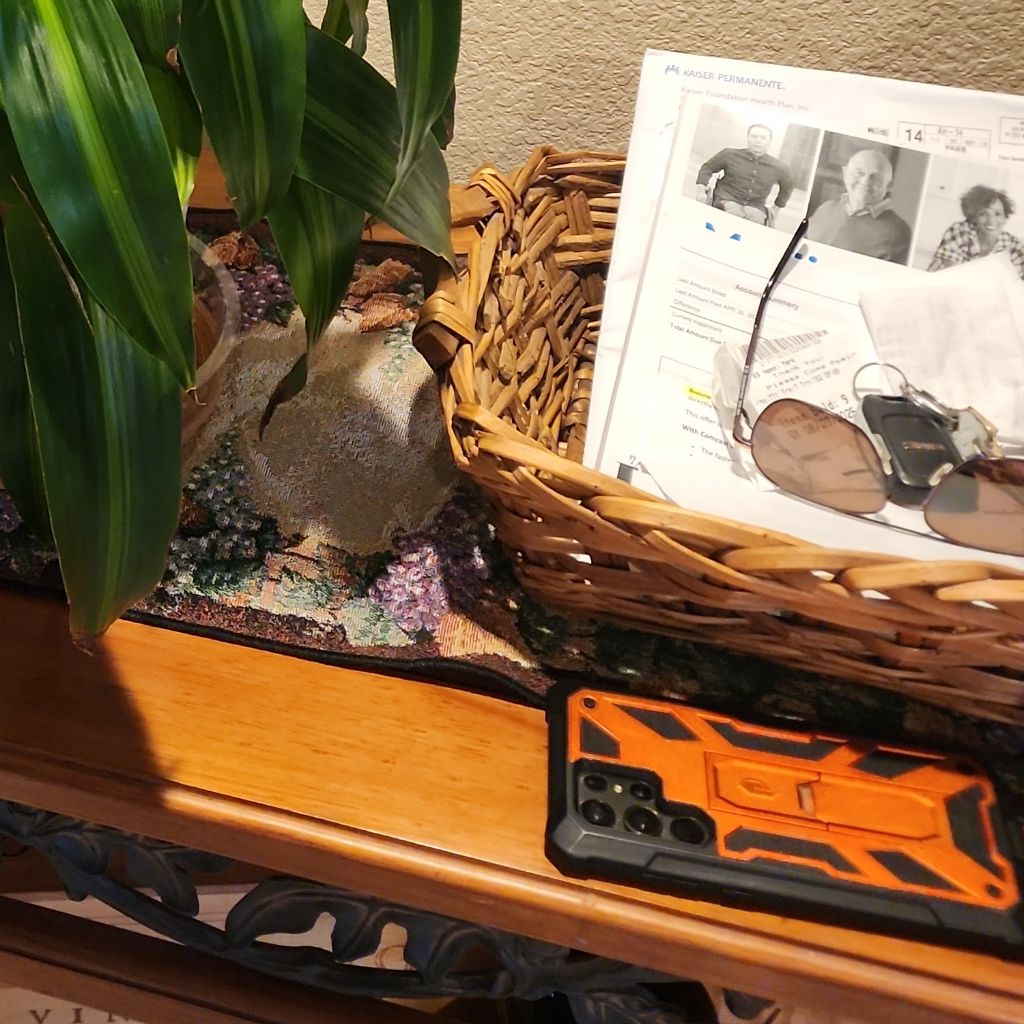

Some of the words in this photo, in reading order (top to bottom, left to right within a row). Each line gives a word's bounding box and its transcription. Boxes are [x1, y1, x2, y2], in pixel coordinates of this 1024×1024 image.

[683, 69, 715, 80] KAISER
[717, 73, 785, 91] PERMANENTE
[905, 128, 923, 143] 14
[767, 297, 800, 311] ummary
[682, 423, 699, 435] With
